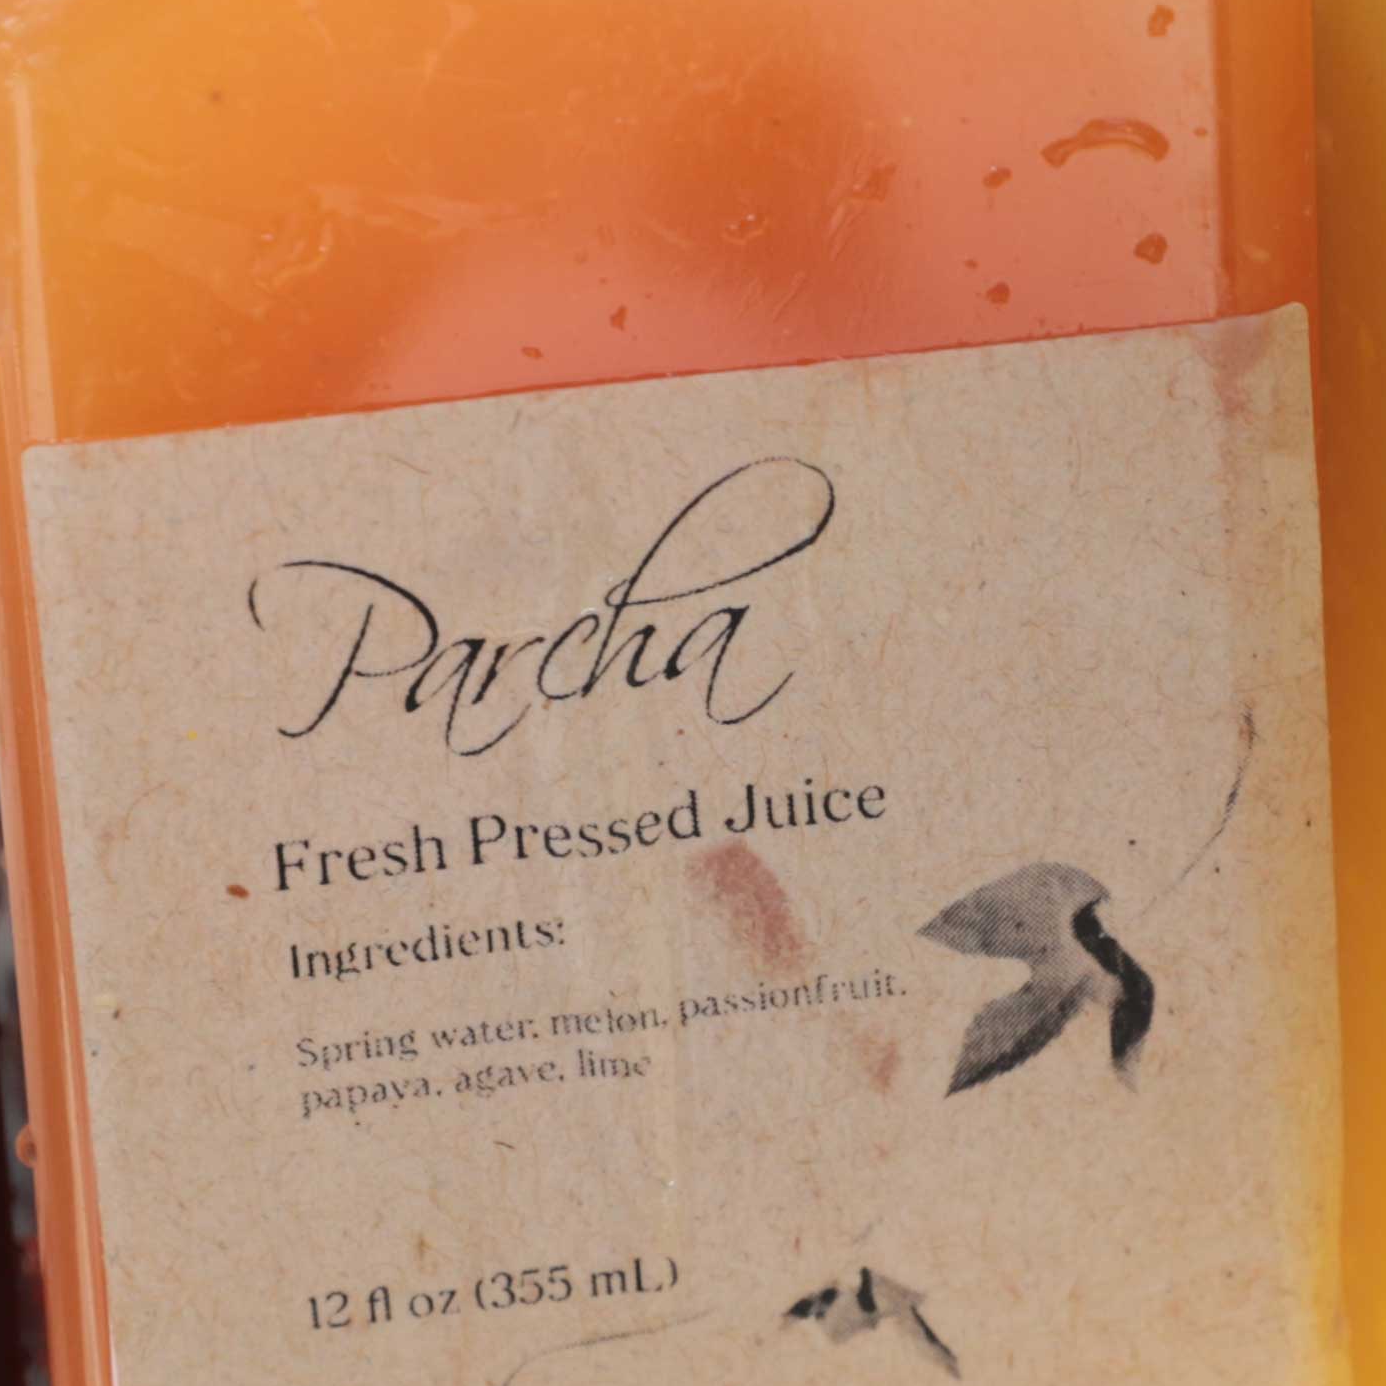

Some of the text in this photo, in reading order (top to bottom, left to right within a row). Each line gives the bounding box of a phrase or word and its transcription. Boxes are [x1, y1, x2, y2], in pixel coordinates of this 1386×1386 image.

[248, 456, 835, 757] Parcha
[273, 779, 887, 891] Fresh Pressed Juice
[289, 918, 566, 982] Ingredients:
[297, 1029, 419, 1071] Spring
[430, 1013, 540, 1051] water,
[578, 1046, 651, 1079] lime
[308, 1256, 680, 1331] 12 fl oz (355 mL)
